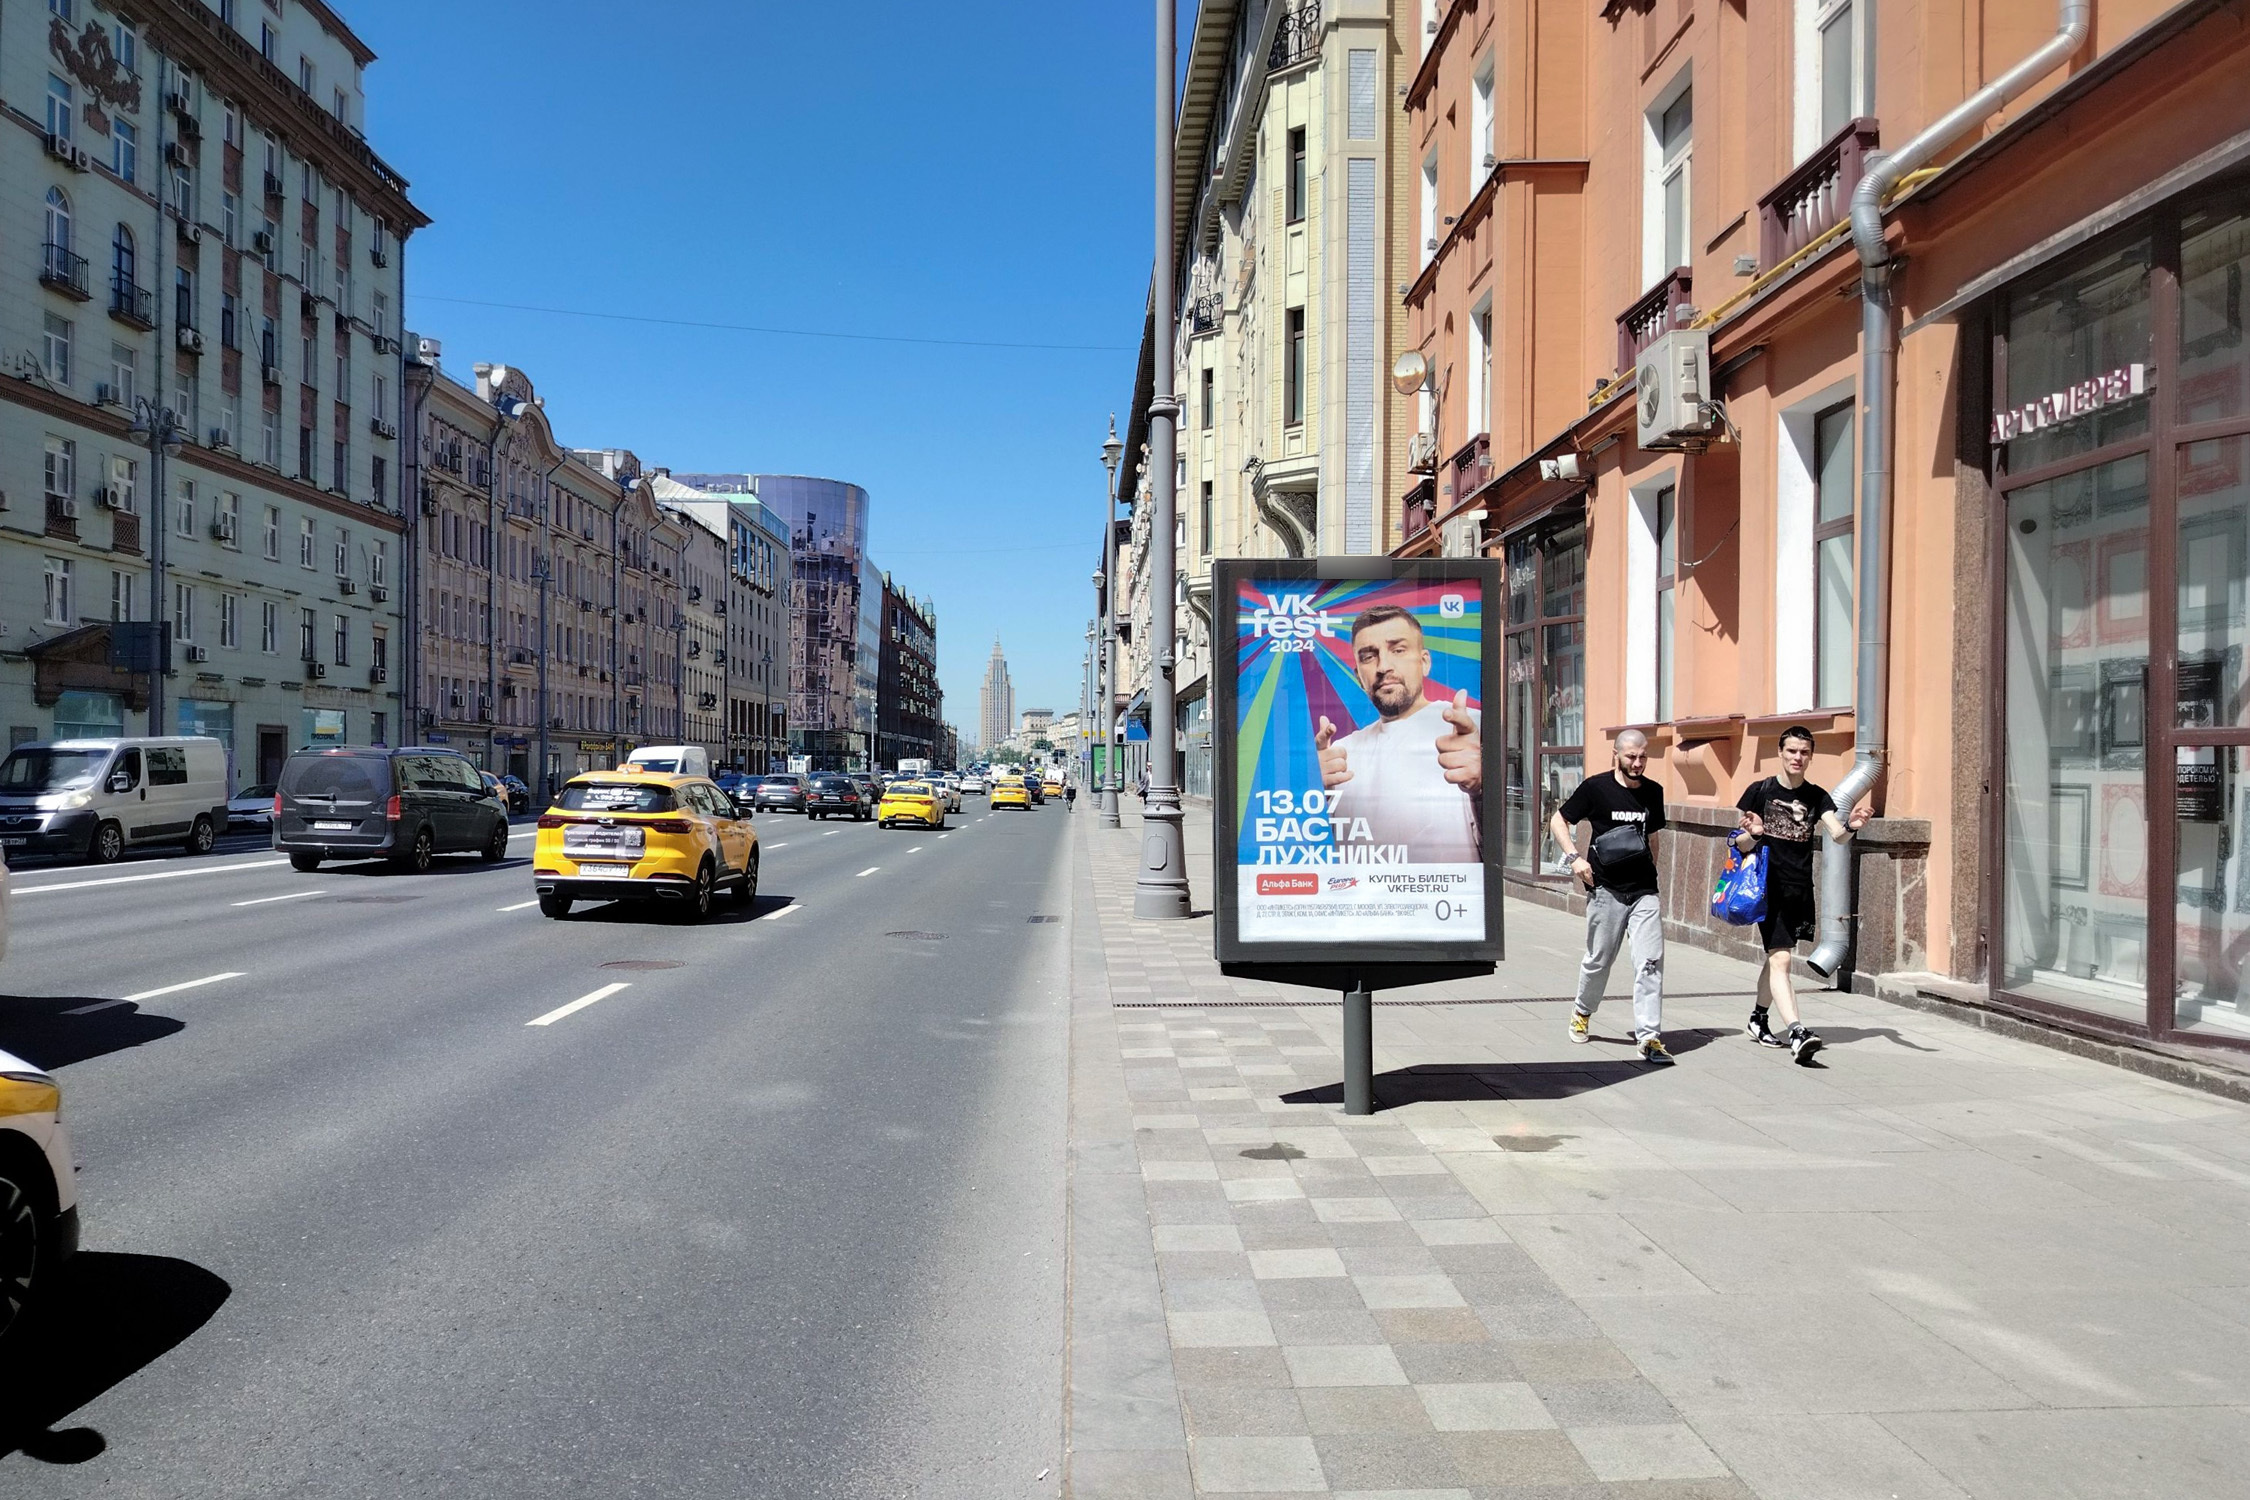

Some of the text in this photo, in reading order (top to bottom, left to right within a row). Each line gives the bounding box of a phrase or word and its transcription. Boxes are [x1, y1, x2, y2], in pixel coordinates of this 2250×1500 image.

[1266, 594, 1318, 615] VK
[1238, 608, 1343, 638] fest
[1269, 639, 1315, 653] 2024
[1255, 789, 1345, 815] 13.07
[1255, 817, 1374, 842] БАСТА
[1256, 844, 1409, 866] ЛУЖНИКИ
[1261, 878, 1313, 891] Альфа Банк
[1368, 874, 1467, 883] КУПИТЬ БИЛЕТЫ
[1387, 884, 1449, 893] VKFEST.RU
[1435, 899, 1468, 921] 0+
